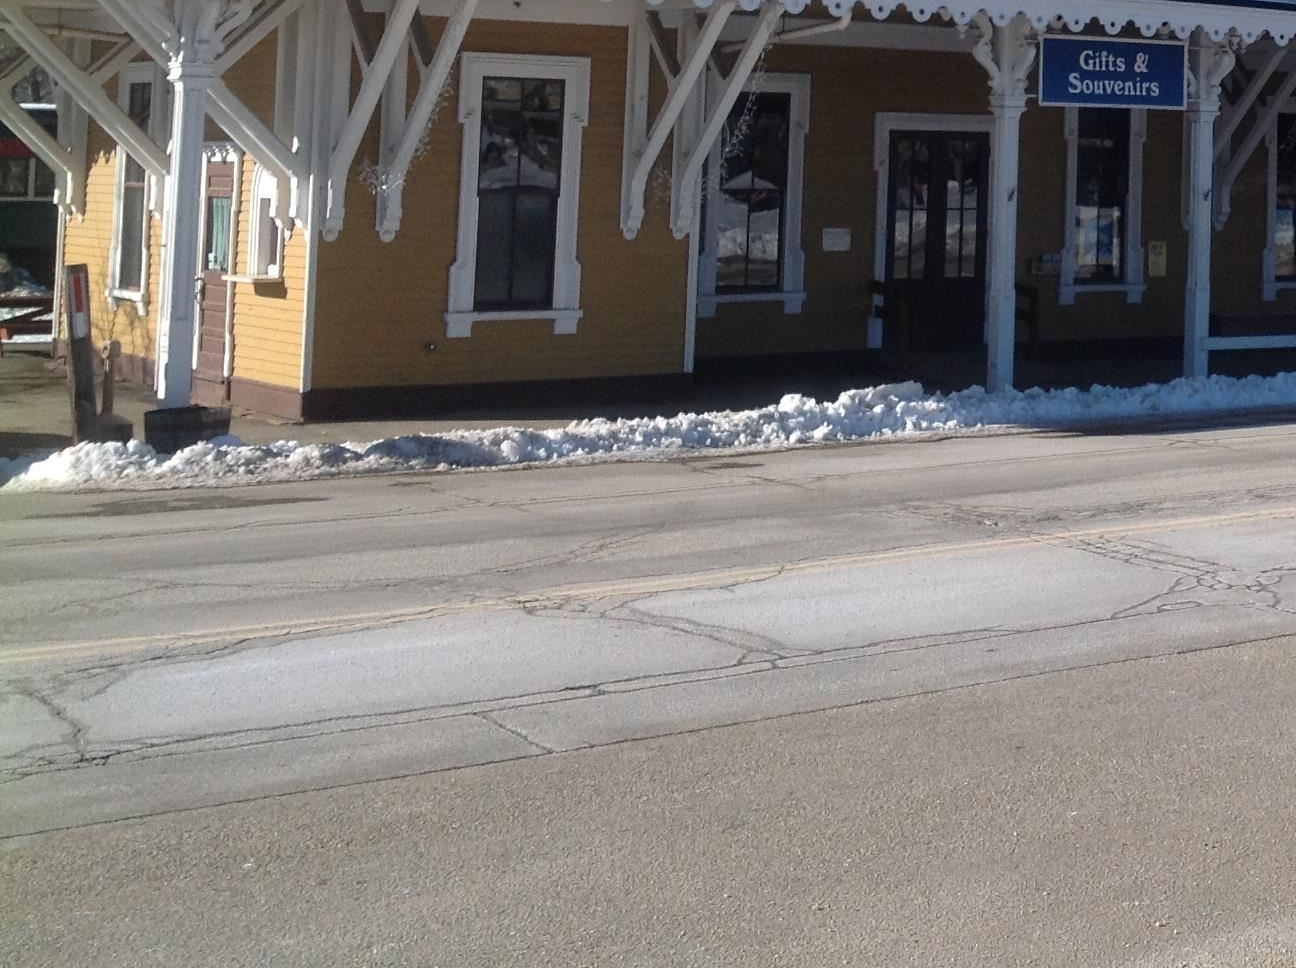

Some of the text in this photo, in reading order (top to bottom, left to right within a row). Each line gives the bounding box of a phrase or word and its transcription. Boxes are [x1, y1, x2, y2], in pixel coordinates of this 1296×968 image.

[1079, 50, 1149, 73] Gifts &
[1068, 73, 1160, 97] Souvenirs
